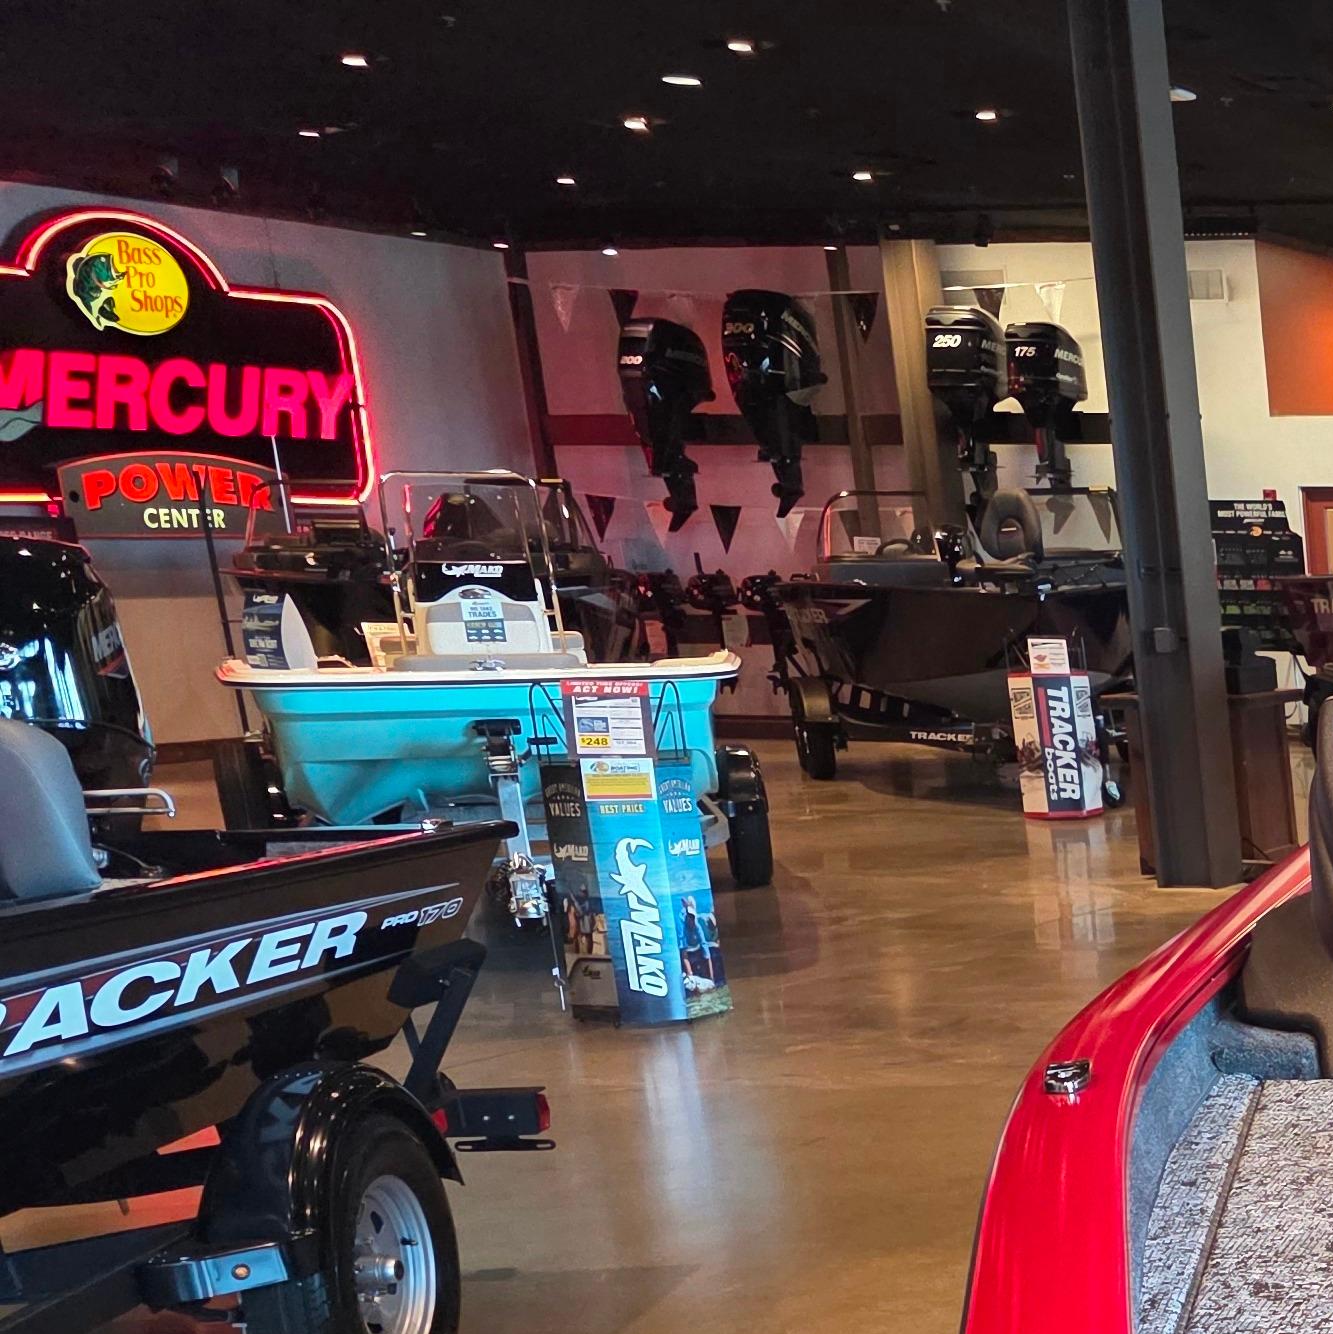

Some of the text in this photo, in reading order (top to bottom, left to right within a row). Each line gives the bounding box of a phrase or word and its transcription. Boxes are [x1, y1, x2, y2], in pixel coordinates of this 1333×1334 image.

[117, 240, 162, 265] Bass
[125, 266, 156, 288] Pro
[130, 292, 184, 318] Shops
[932, 334, 962, 348] 250
[1014, 346, 1036, 357] 175
[0, 350, 355, 440] MERCURY
[81, 462, 275, 512] POWER
[581, 736, 609, 746] $248
[1047, 686, 1081, 800] TRACKER
[1044, 747, 1059, 801] boats
[549, 803, 582, 818] VALUES
[600, 803, 645, 814] BEST PRICE
[662, 797, 692, 813] VALUES
[380, 897, 464, 930] PRO 170
[622, 892, 669, 998] MAKO
[0, 911, 368, 1056] ACKER
